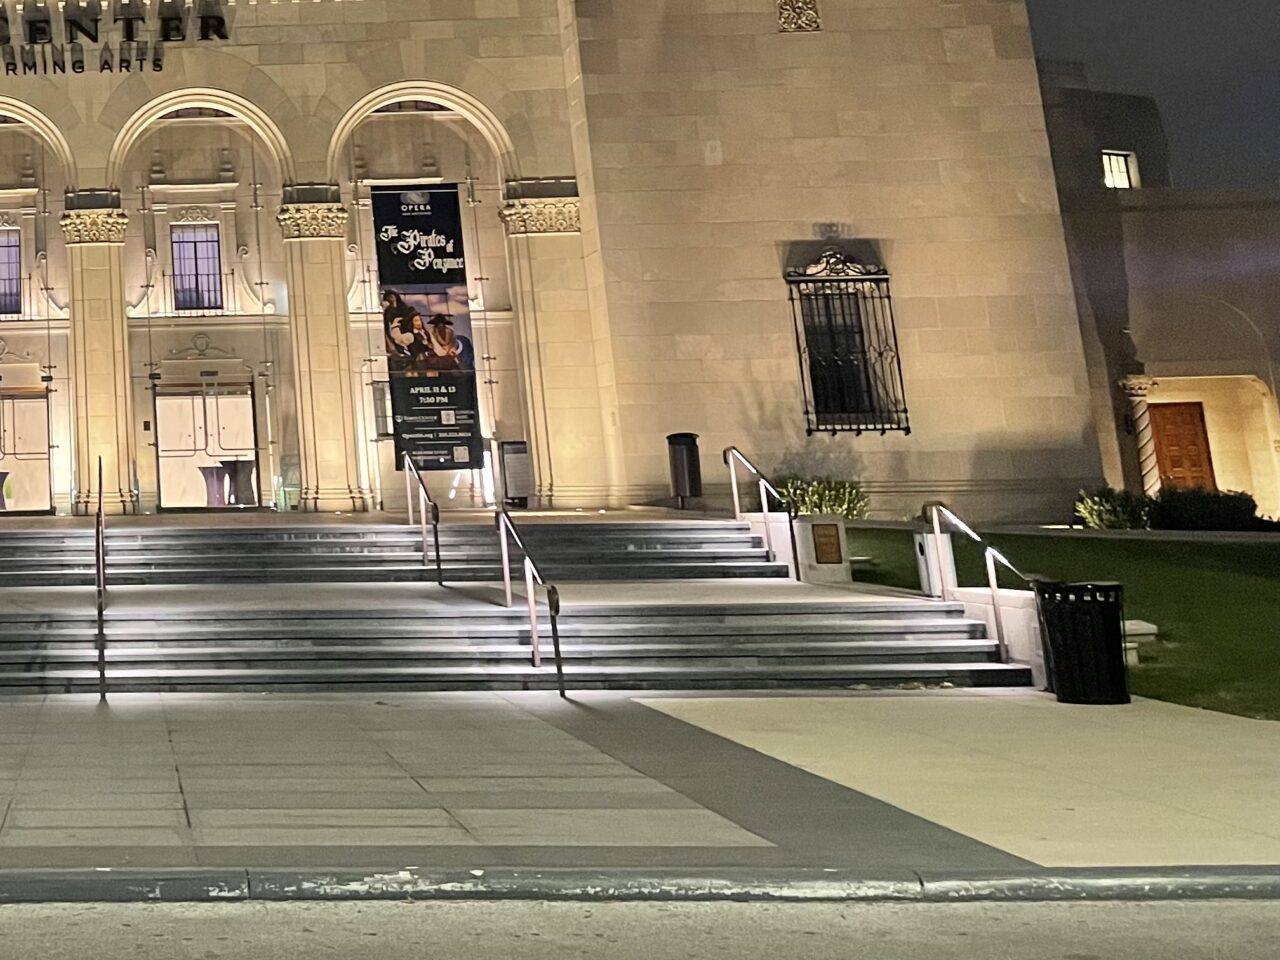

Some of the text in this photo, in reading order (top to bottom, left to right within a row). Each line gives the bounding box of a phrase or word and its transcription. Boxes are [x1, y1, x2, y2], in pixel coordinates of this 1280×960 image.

[100, 58, 163, 74] ARTS
[401, 204, 431, 212] OPERA
[397, 229, 446, 254] Pirates
[414, 248, 464, 273] Penzance
